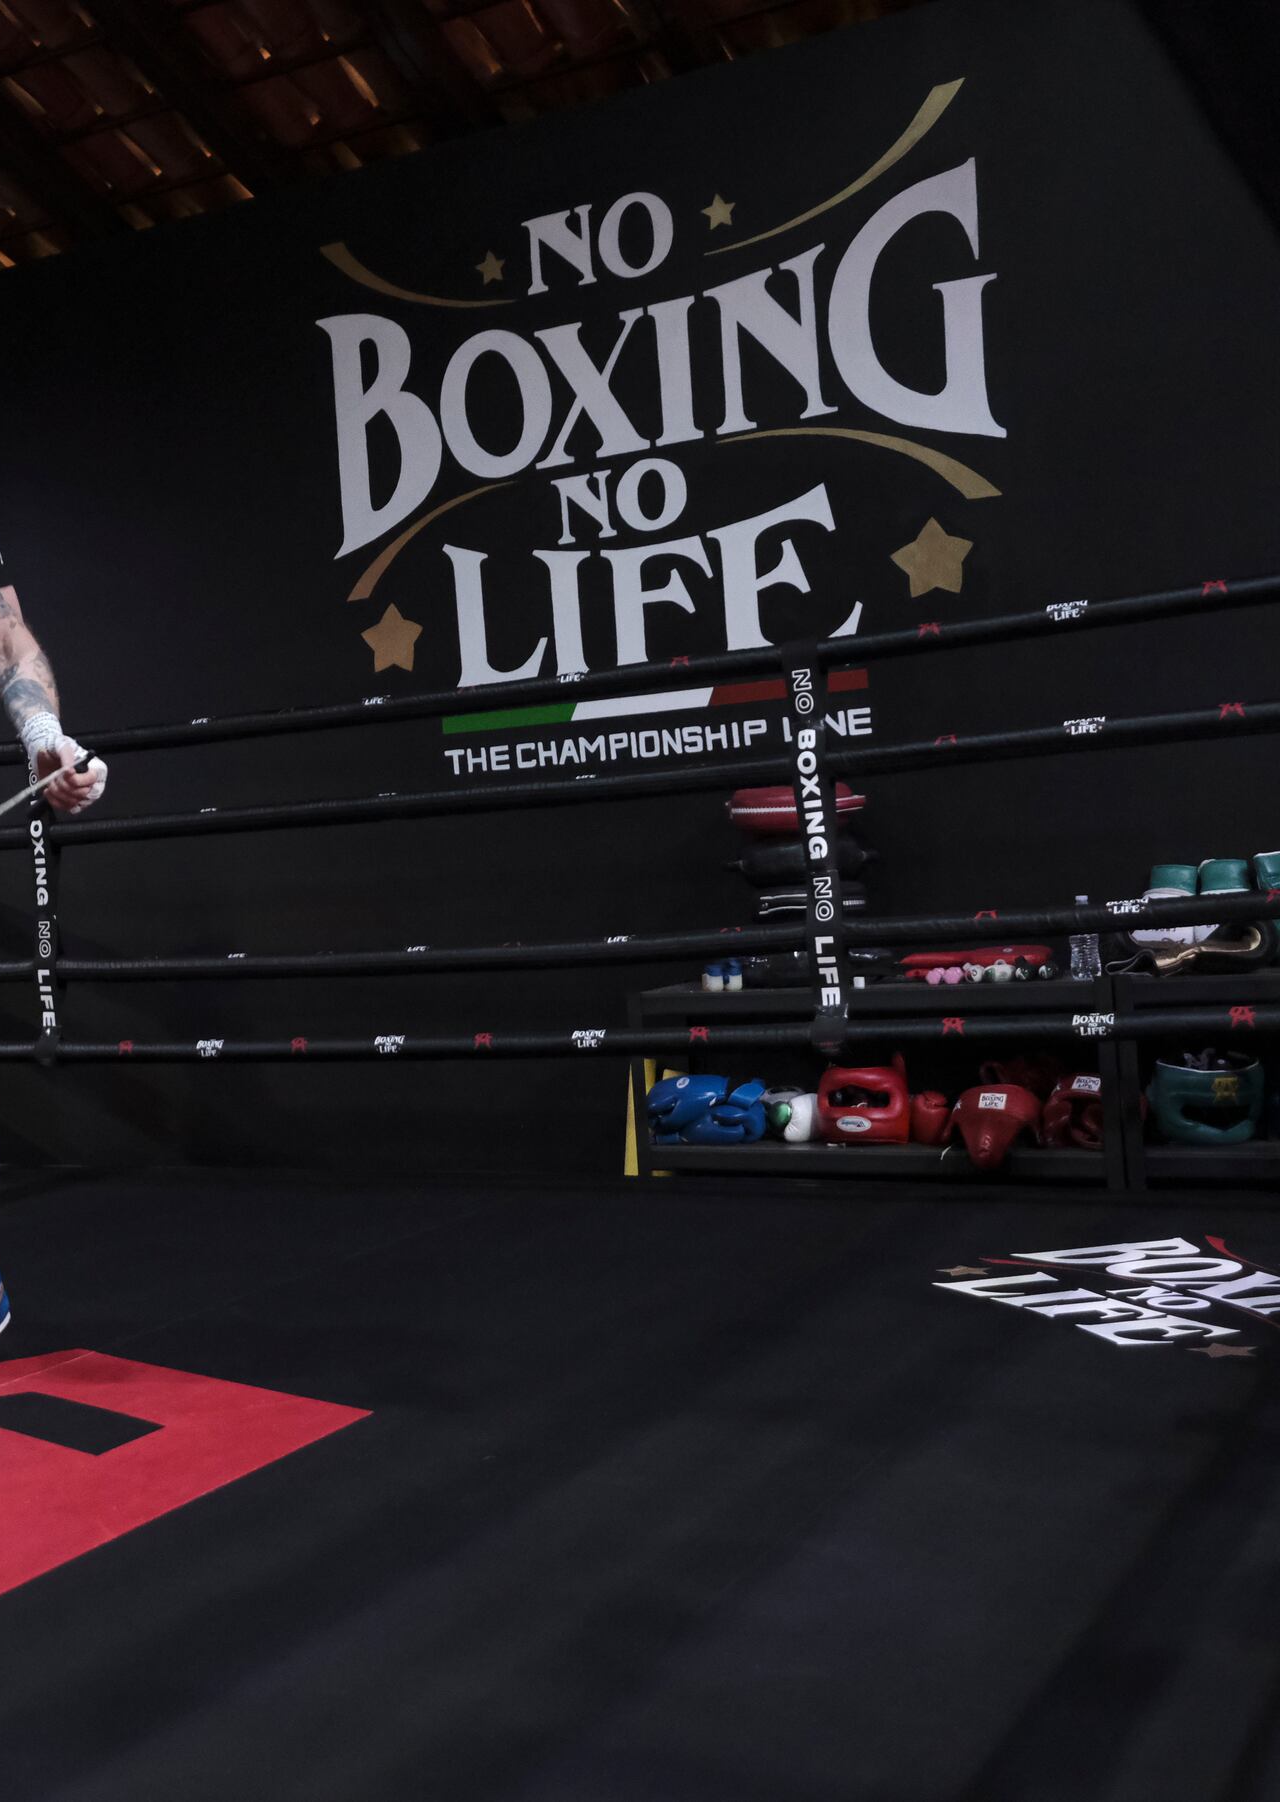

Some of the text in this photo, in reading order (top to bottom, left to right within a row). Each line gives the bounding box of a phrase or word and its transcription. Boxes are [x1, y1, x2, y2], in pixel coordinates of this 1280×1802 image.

[521, 190, 674, 296] NO
[315, 156, 1008, 560] BOXING
[550, 458, 688, 545] NO
[441, 482, 864, 688] LIFE
[1053, 608, 1081, 621] LIFE
[444, 707, 872, 776] THE CHAMPIONSHIP LNE
[1070, 724, 1098, 736] LIFE
[30, 799, 50, 907] OXING
[791, 667, 842, 1007] NO BOXING NO LIFE
[38, 920, 52, 959] NO
[1113, 904, 1140, 915] LIFE
[37, 968, 57, 1029] LIFE
[1072, 1012, 1115, 1026] BOXING
[577, 1039, 598, 1048] LIFE
[1080, 1026, 1107, 1036] LIFE
[931, 1271, 1242, 1345] LIFE
[1105, 1285, 1211, 1311] NO
